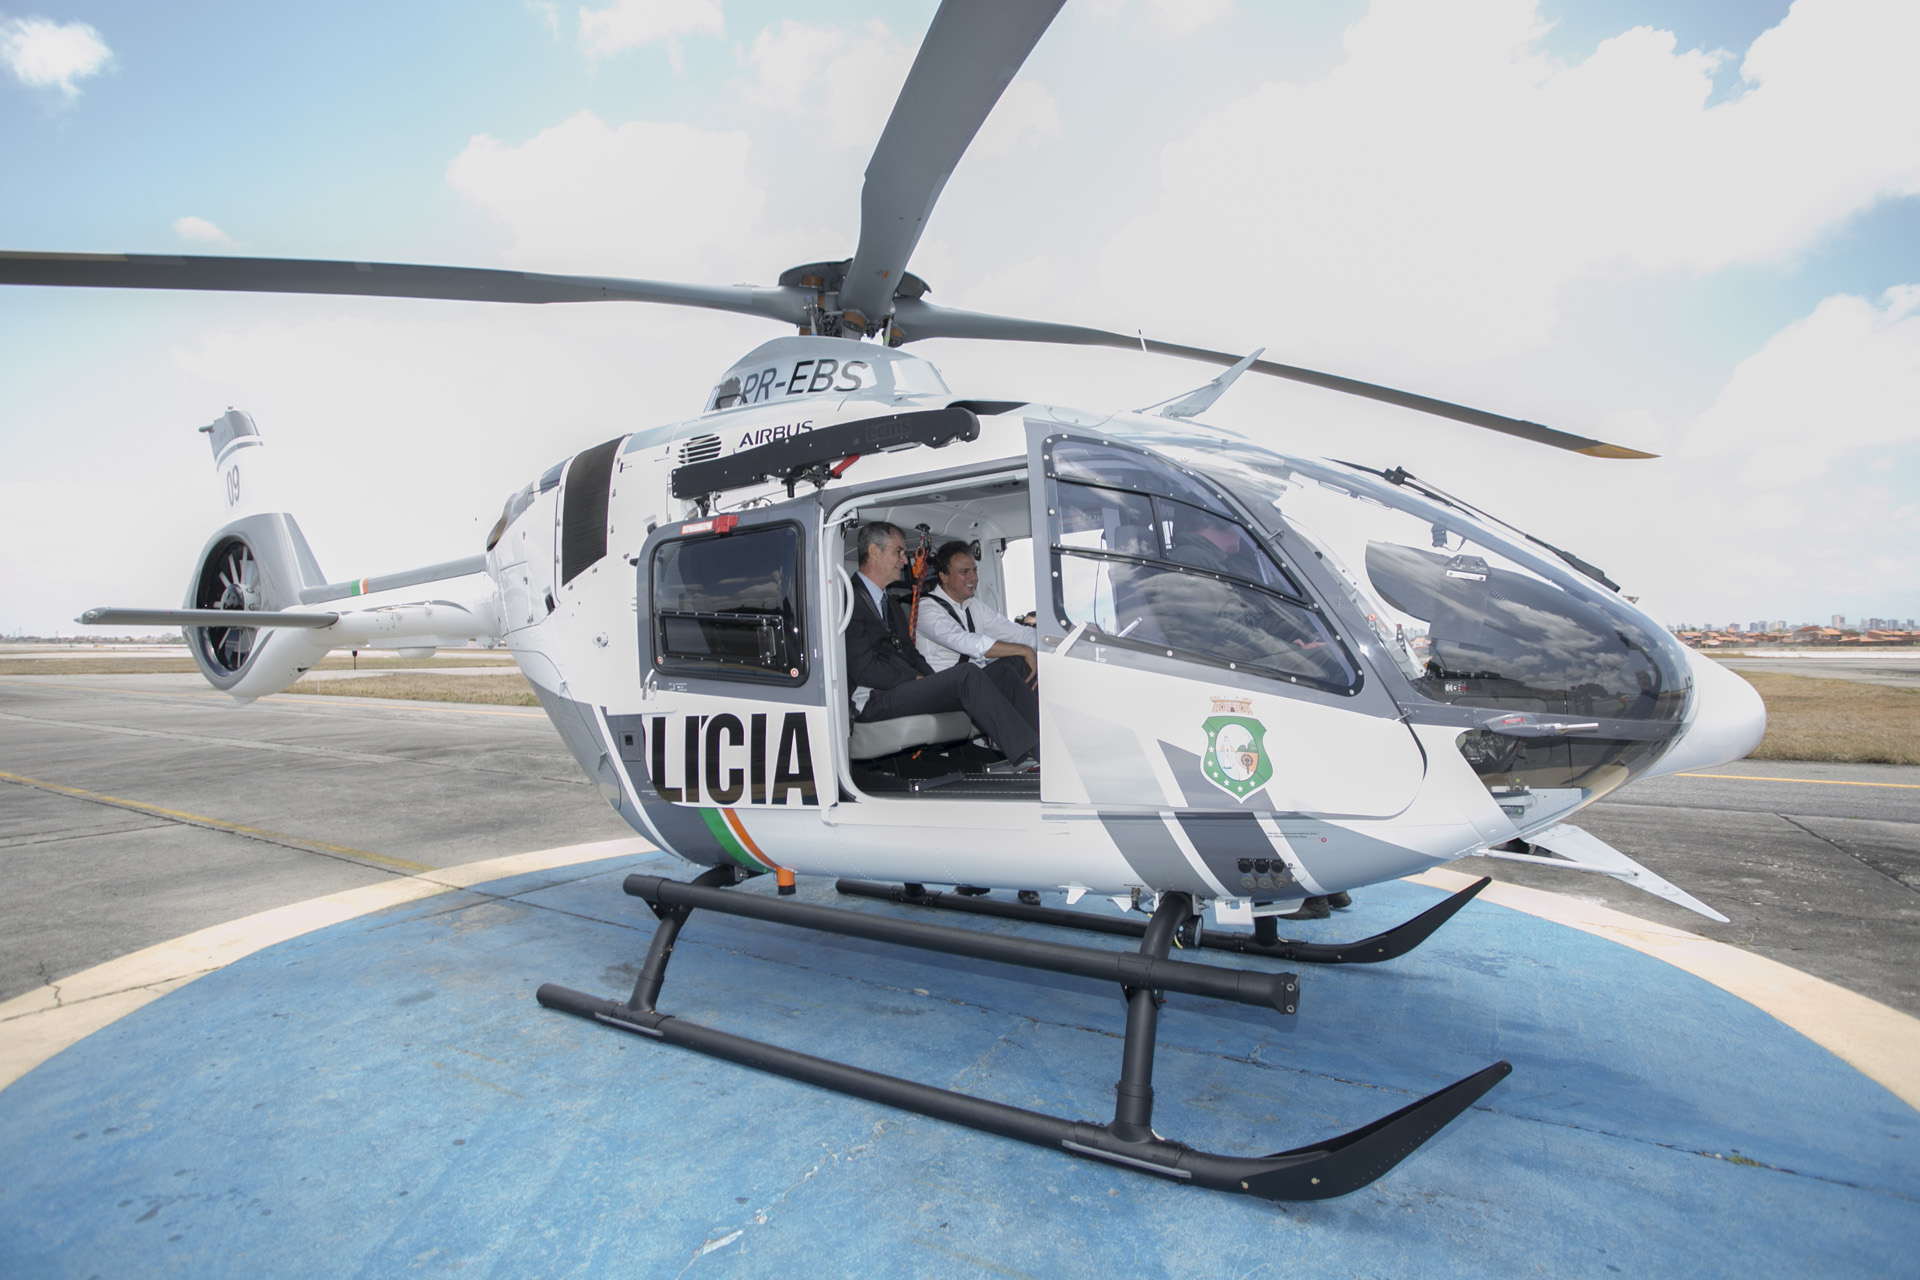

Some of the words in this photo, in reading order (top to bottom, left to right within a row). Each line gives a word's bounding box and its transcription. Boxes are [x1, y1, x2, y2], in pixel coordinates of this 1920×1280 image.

[739, 358, 868, 404] PR-EBS
[739, 420, 814, 448] AIRBUS
[226, 464, 240, 507] 09
